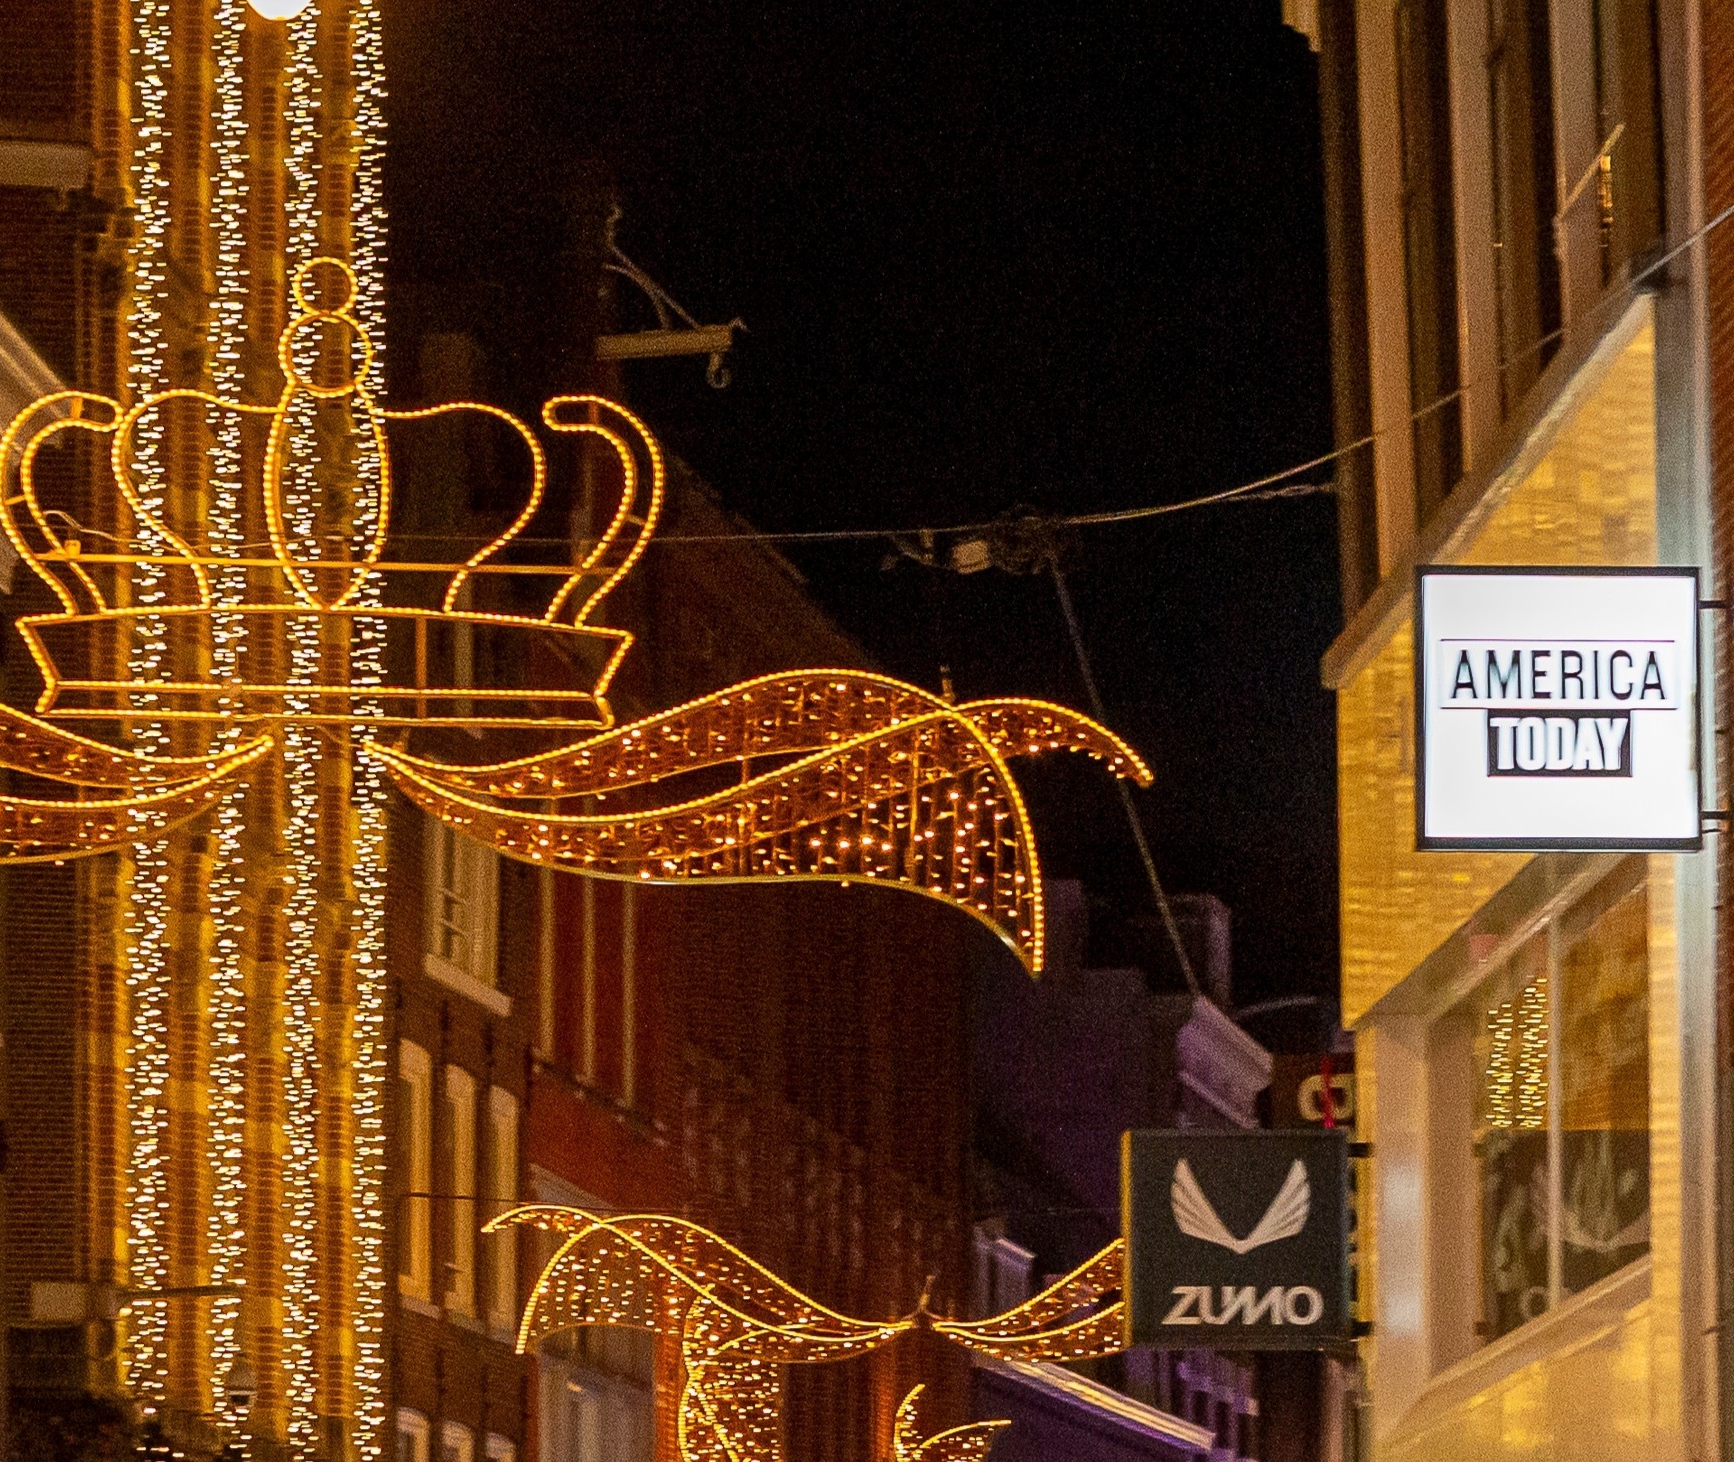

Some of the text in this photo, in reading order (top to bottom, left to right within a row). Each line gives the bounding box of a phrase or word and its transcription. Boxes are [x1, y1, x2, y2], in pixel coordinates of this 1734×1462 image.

[1450, 649, 1666, 700] AMERICA
[1489, 716, 1629, 772] TODAY
[1161, 1285, 1324, 1326] ZUMO
